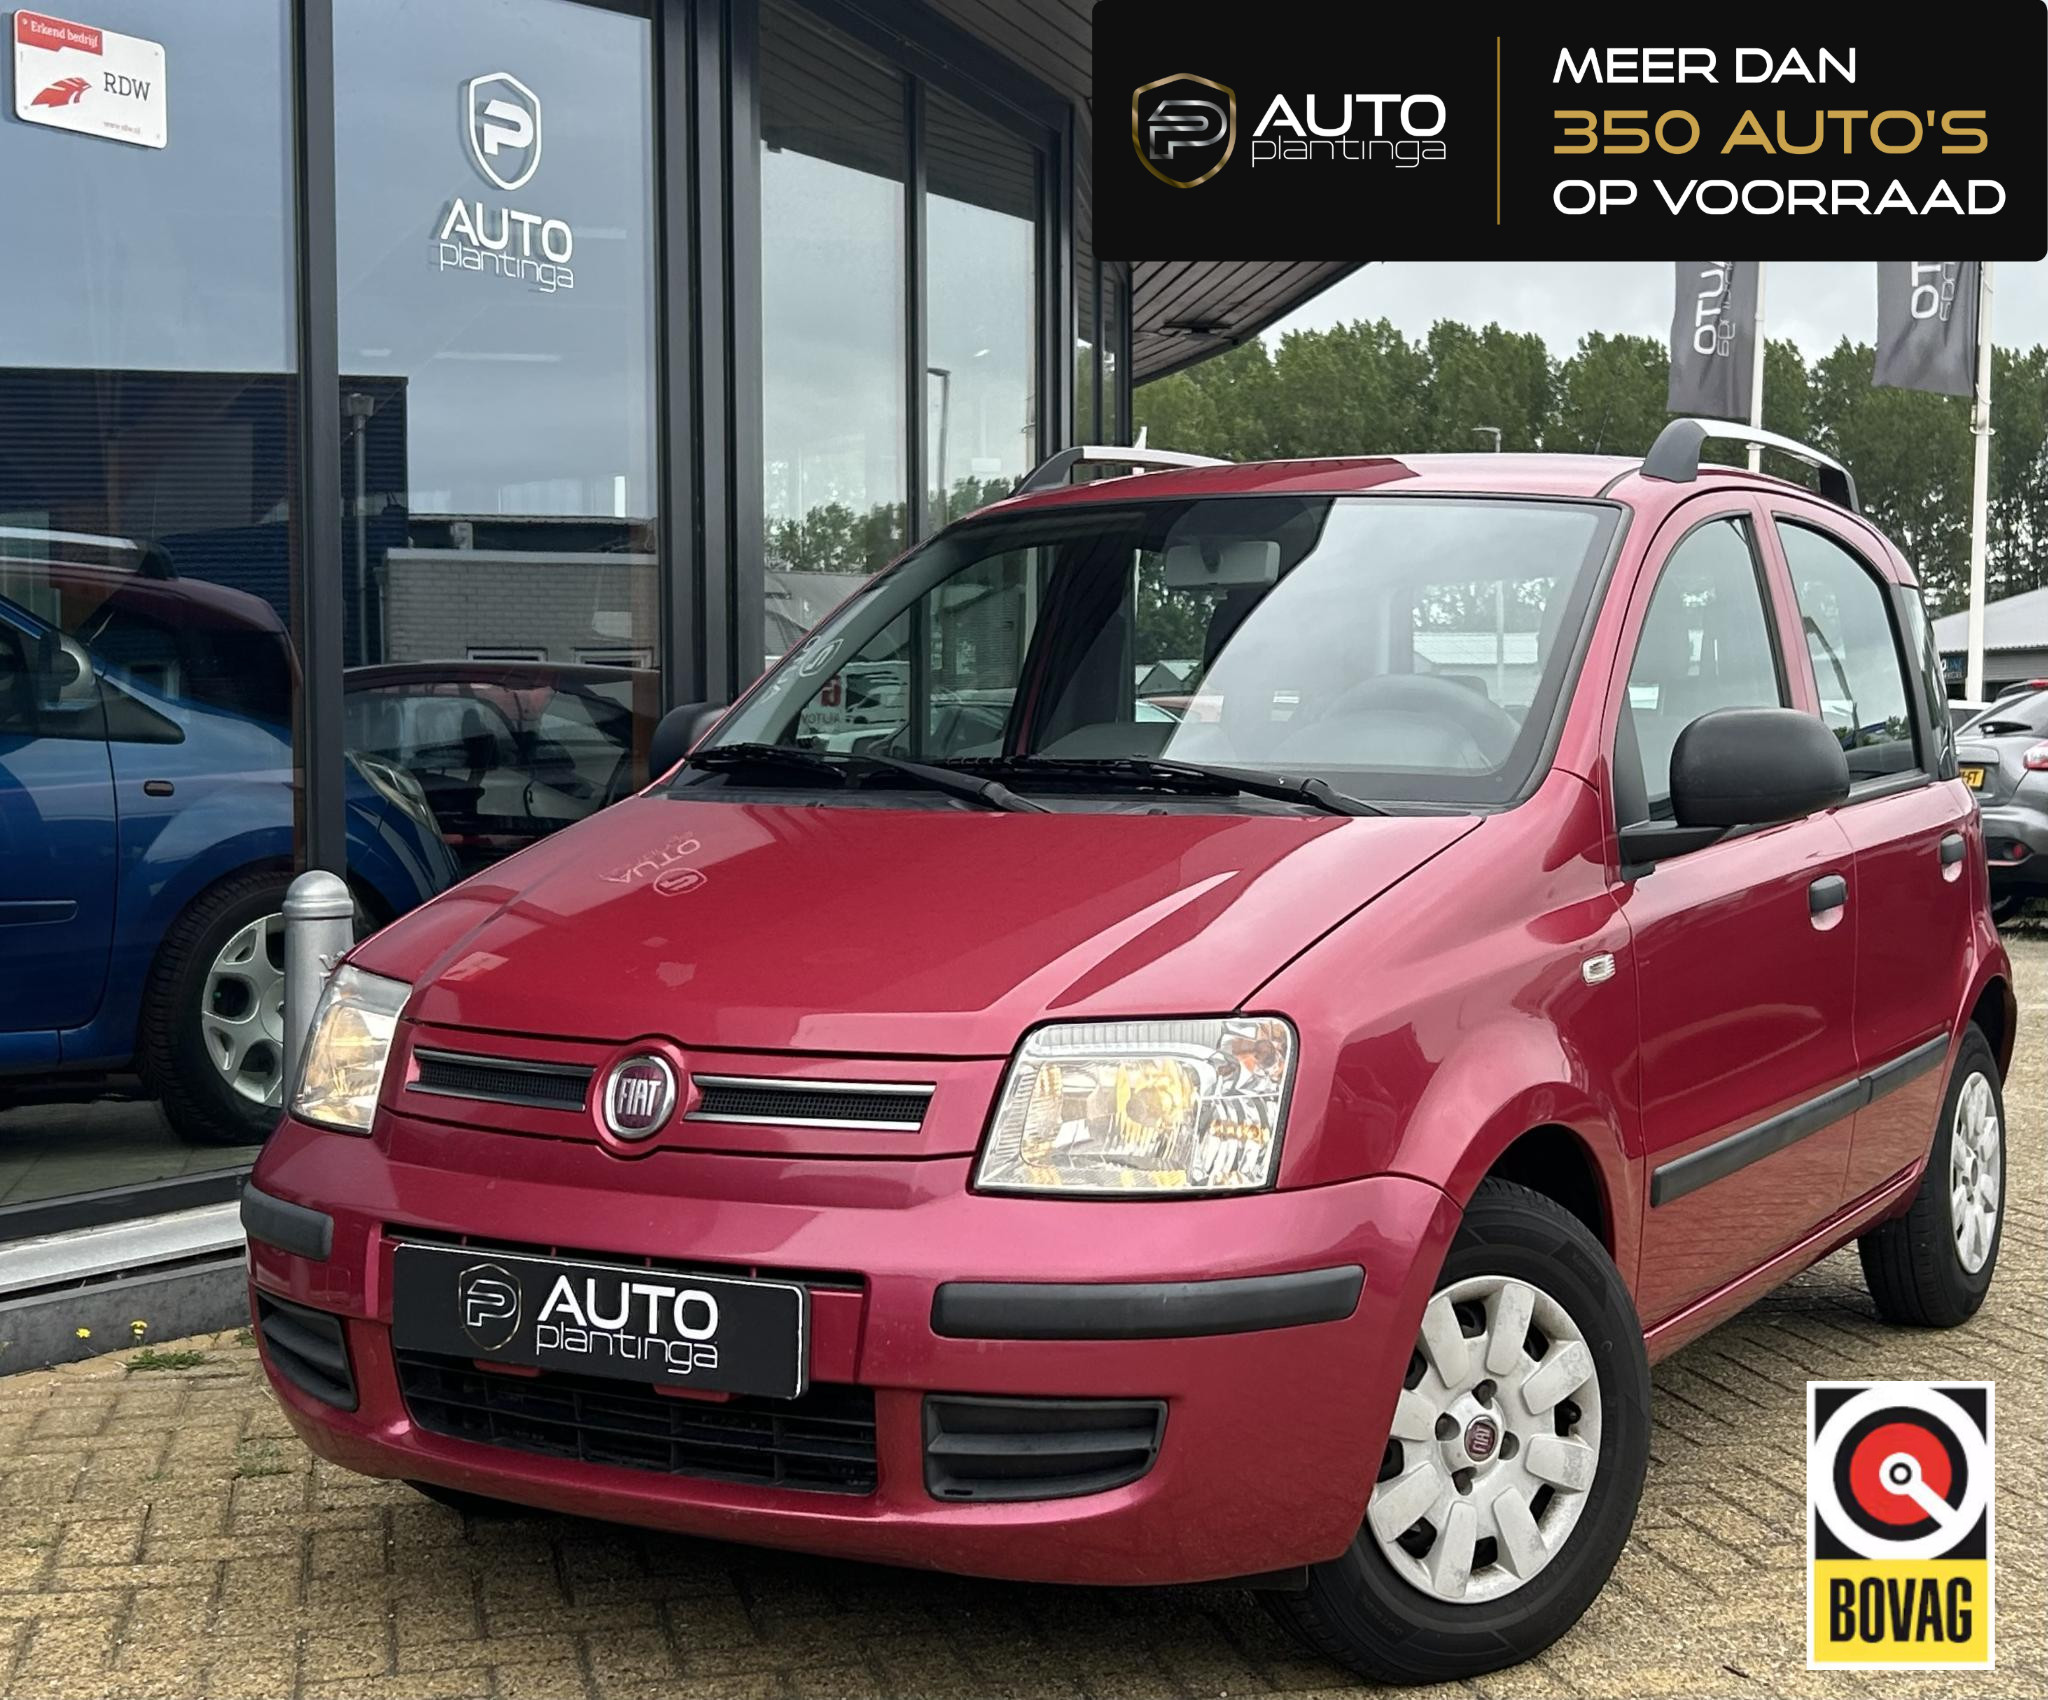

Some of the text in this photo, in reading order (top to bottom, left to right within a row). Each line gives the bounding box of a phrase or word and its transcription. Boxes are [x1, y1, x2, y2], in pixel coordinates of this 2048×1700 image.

[30, 20, 99, 49] Erkend bedrijf
[103, 72, 151, 102] RDW
[440, 198, 573, 263] AUTO
[440, 242, 574, 293] plantinga
[617, 1078, 662, 1117] FIAT
[537, 1275, 719, 1341] AUTO
[536, 1324, 719, 1375] plantinga
[1472, 1425, 1491, 1453] FIAT
